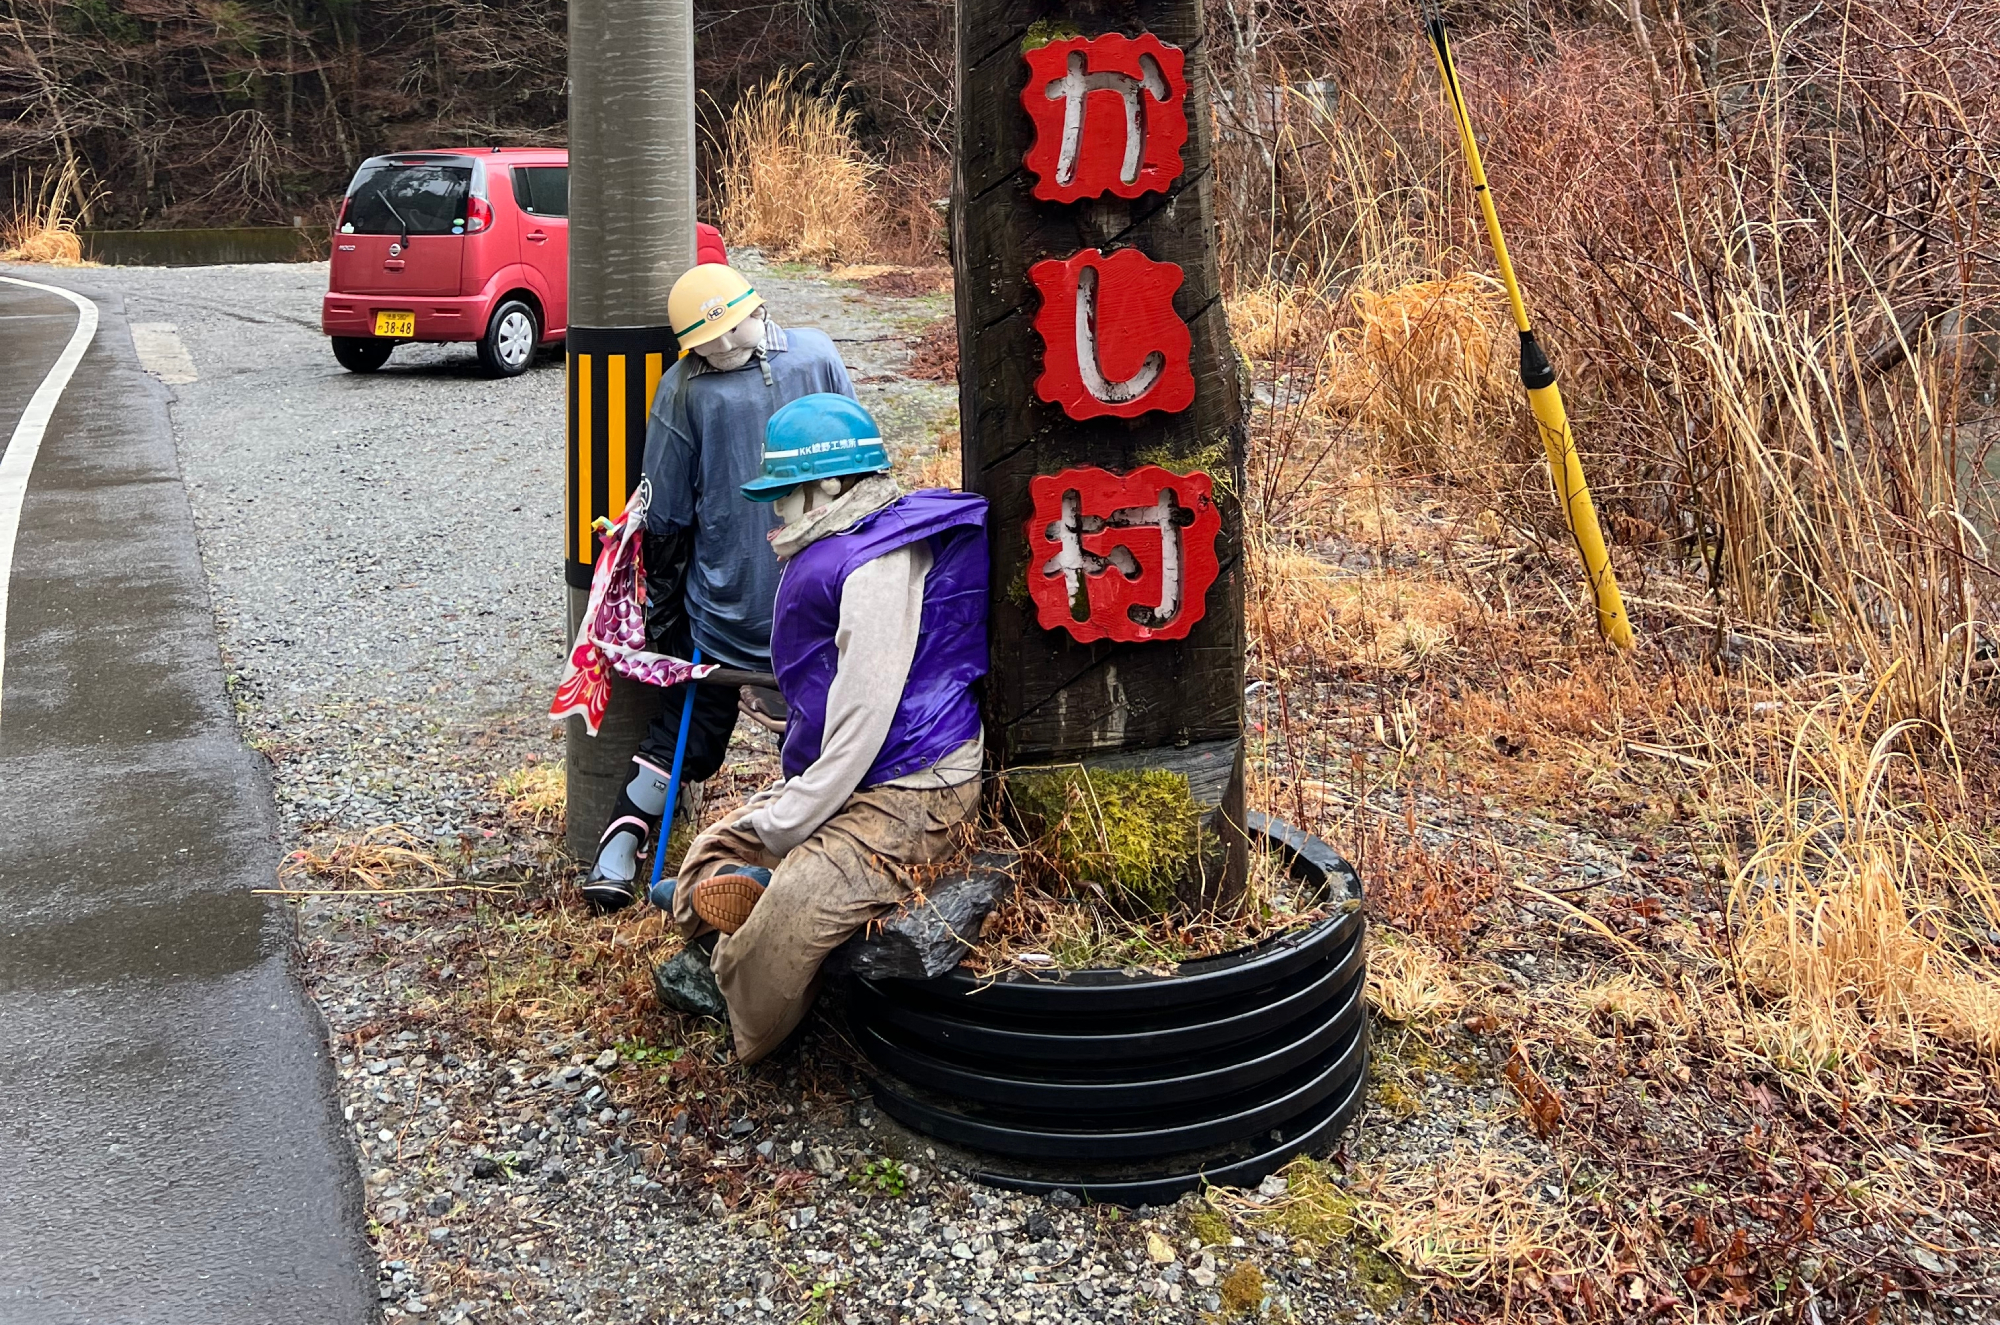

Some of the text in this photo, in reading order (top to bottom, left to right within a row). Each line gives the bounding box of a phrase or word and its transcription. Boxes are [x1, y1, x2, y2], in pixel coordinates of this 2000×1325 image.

[384, 322, 411, 334] 38-48
[1044, 49, 1197, 630] かし村
